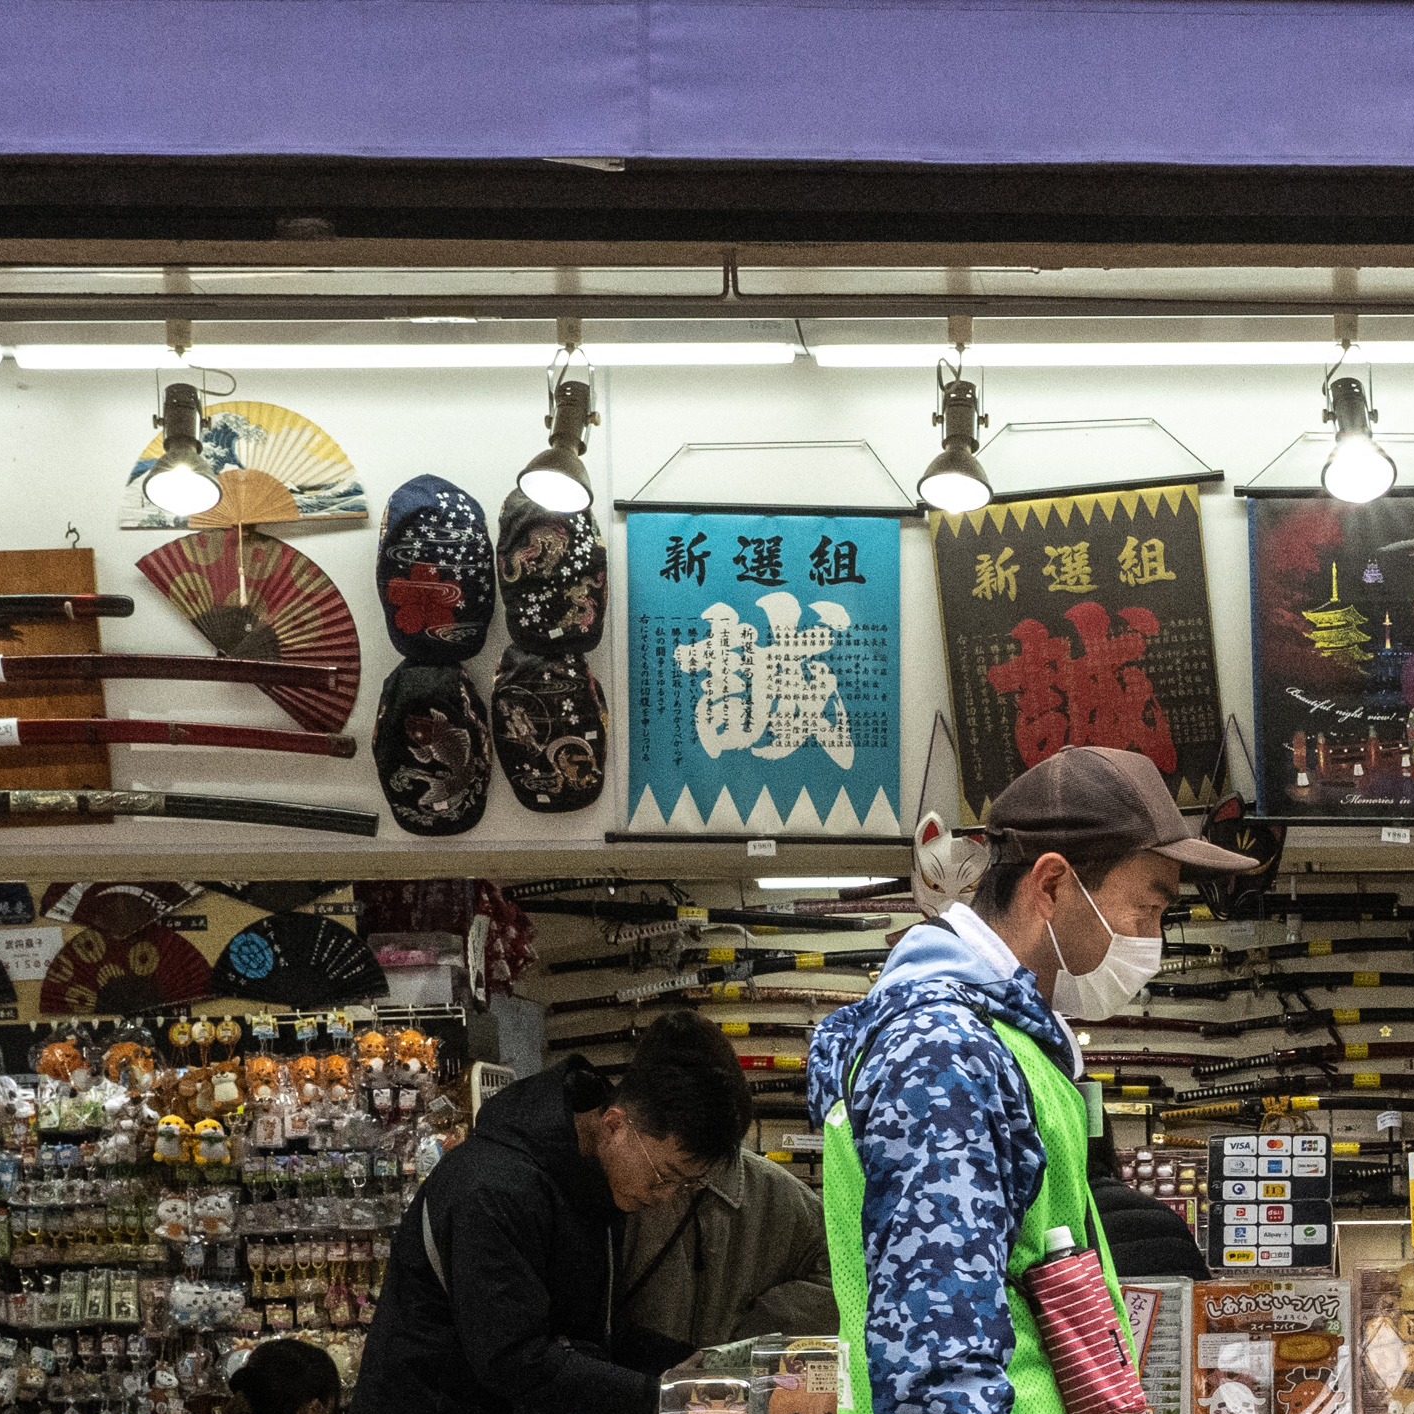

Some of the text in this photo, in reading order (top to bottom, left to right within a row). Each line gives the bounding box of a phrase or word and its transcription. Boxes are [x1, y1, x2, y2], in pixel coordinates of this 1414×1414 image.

[659, 535, 866, 588] 新選組
[972, 538, 1176, 601] 新選組
[674, 592, 854, 769] 誠
[987, 602, 1177, 773] 誠
[1285, 686, 1332, 713] Beautiful
[1335, 699, 1363, 723] night
[1340, 794, 1395, 806] Memories
[1399, 796, 1411, 806] in
[1229, 1142, 1250, 1150] VISA
[1207, 1293, 1340, 1319] しあわせいっパイ
